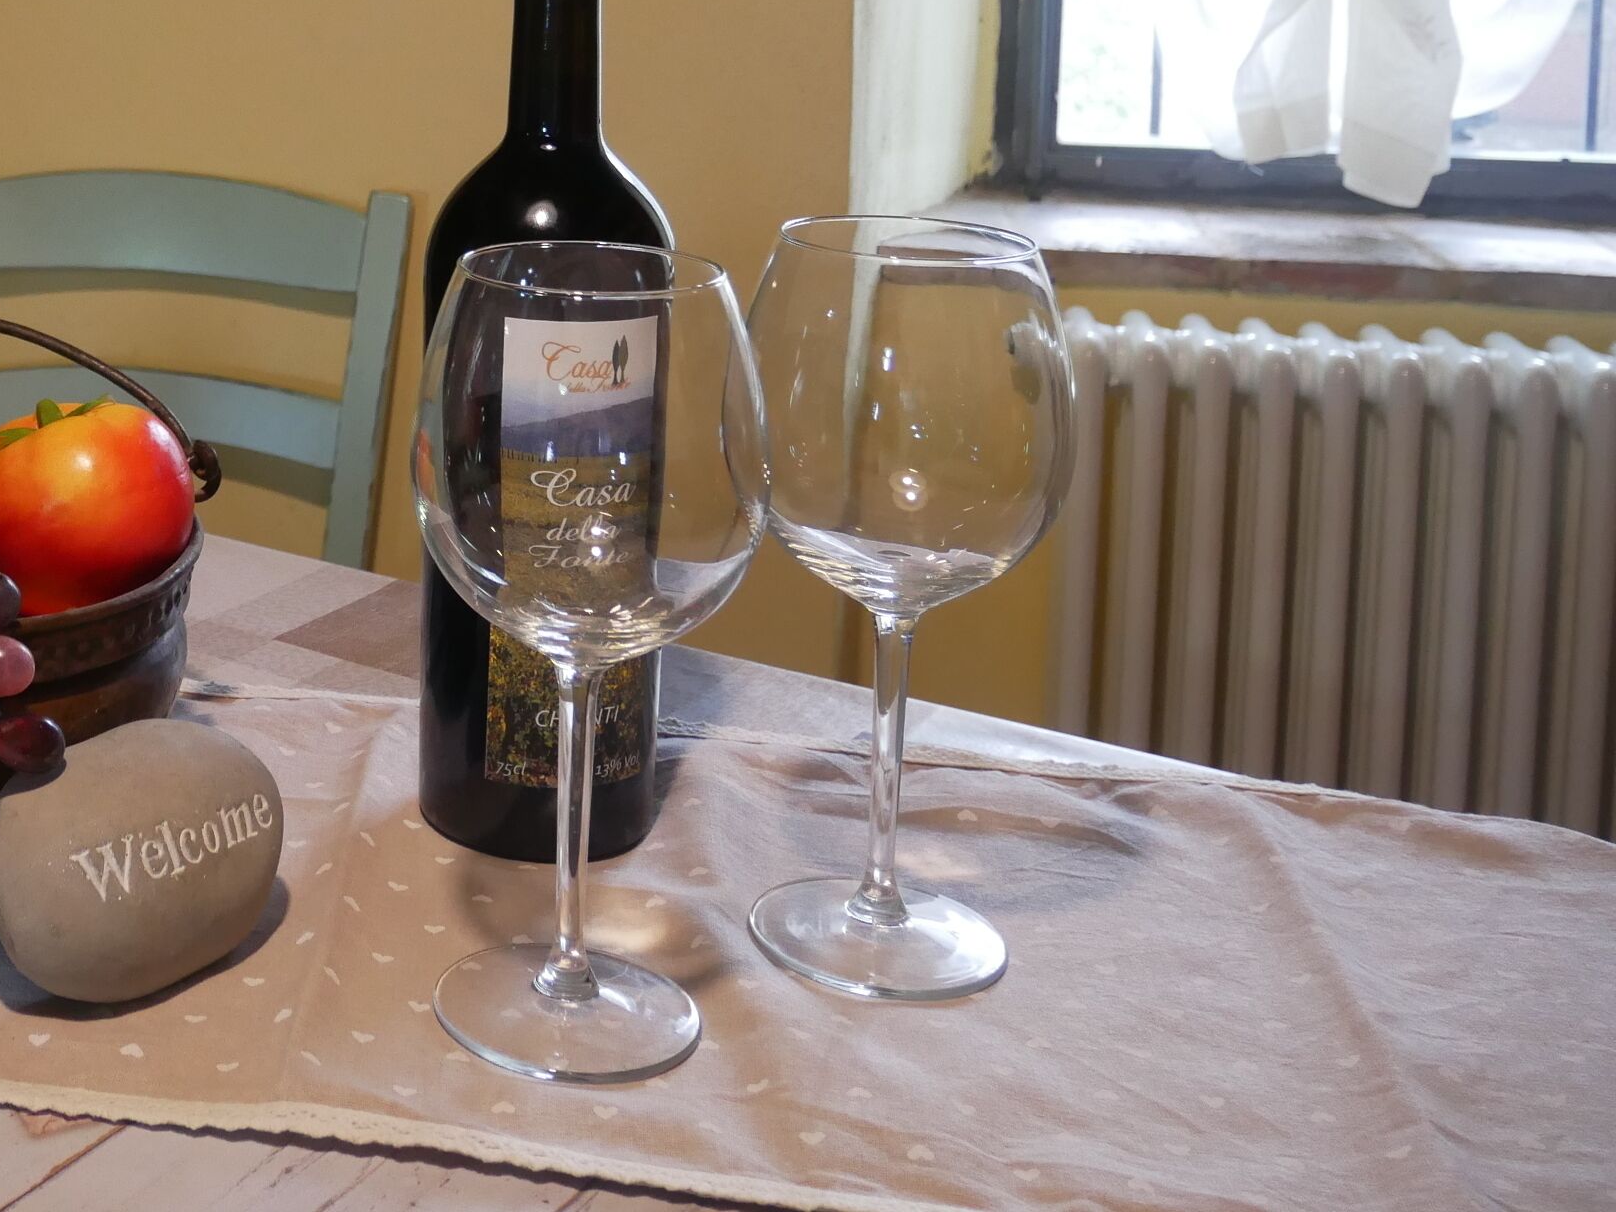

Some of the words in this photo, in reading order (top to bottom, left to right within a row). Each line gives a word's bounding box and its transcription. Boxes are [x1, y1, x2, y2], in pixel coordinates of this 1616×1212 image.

[541, 341, 612, 381] Casa
[530, 468, 636, 507] Casa
[545, 514, 622, 541] della
[528, 544, 630, 569] Fonte
[535, 705, 620, 728] CHNTI
[495, 761, 527, 777] 75cl
[594, 755, 622, 778] 13%
[68, 793, 273, 903] Welcome
